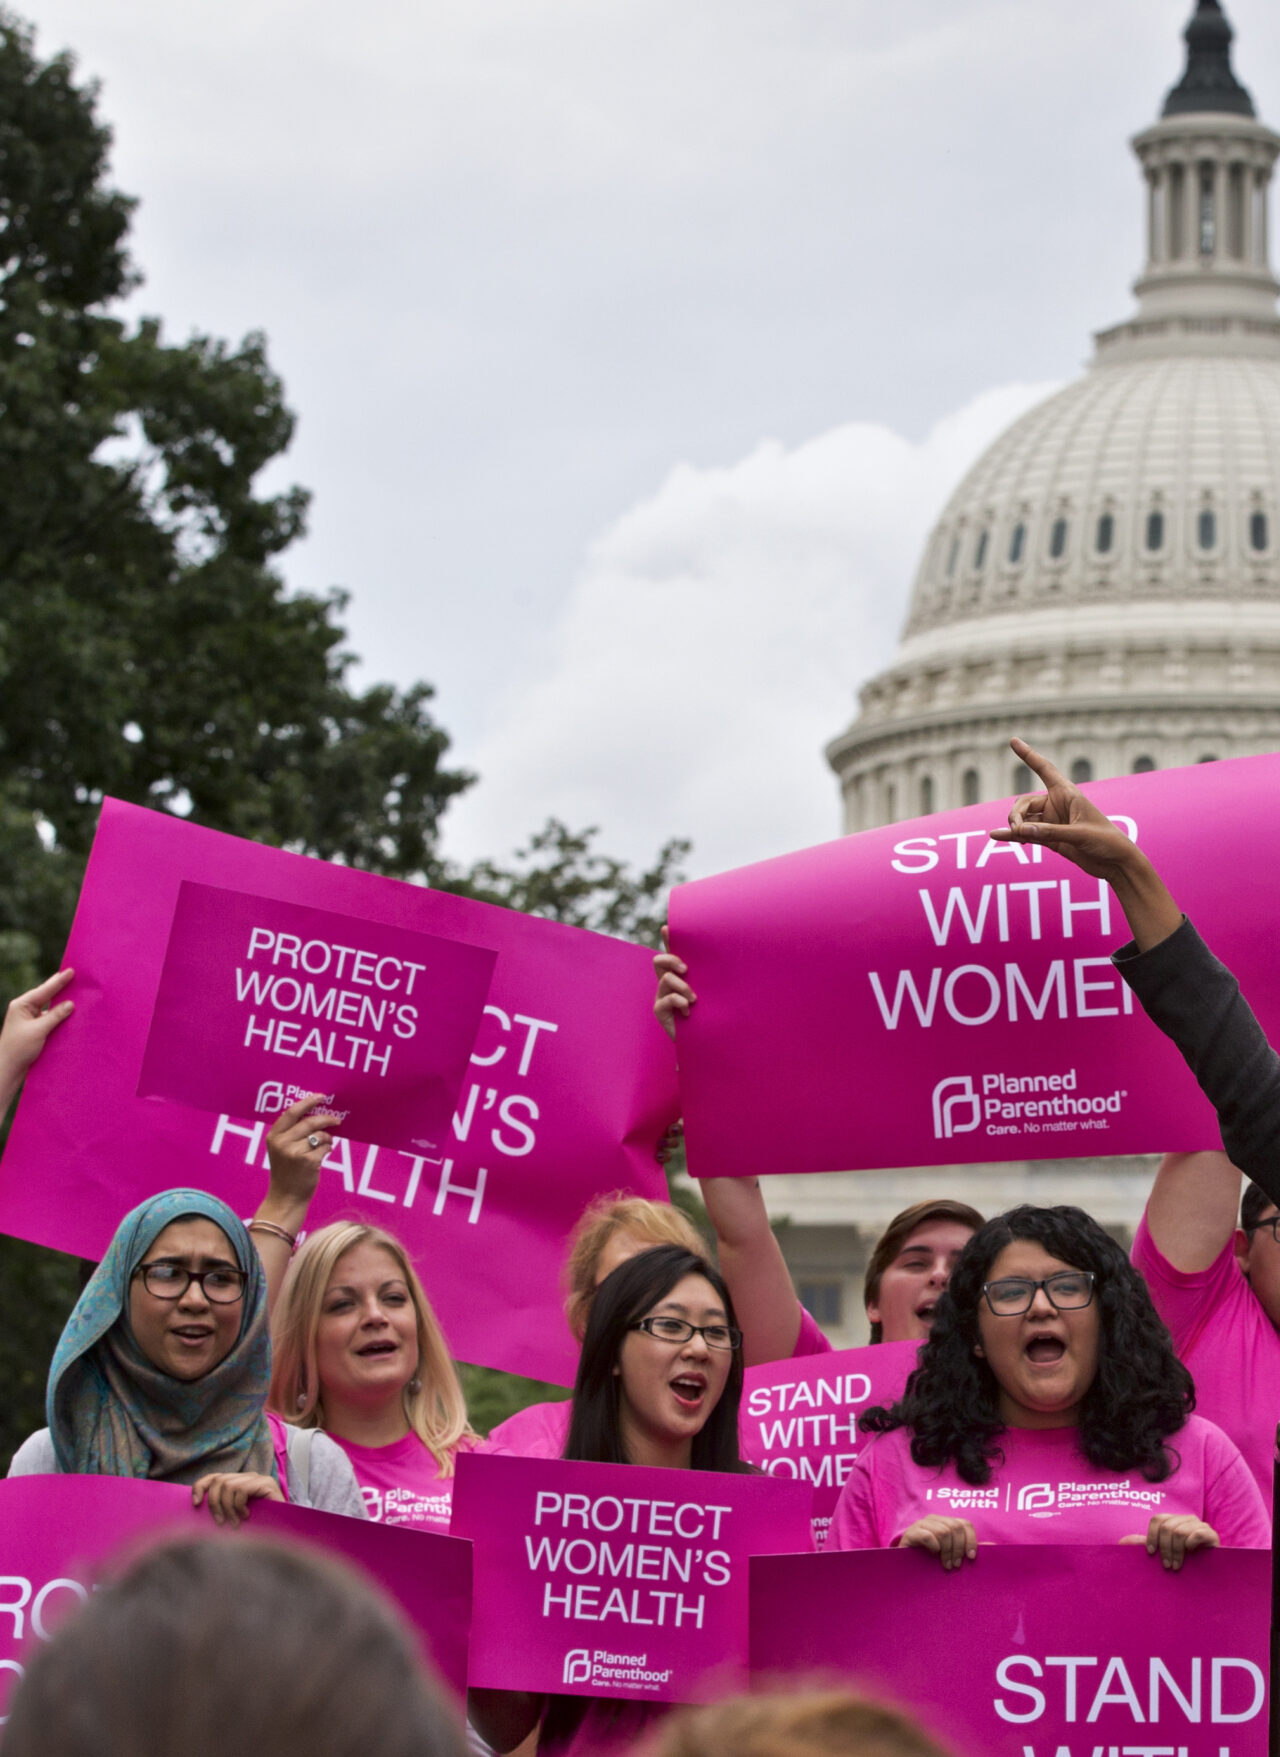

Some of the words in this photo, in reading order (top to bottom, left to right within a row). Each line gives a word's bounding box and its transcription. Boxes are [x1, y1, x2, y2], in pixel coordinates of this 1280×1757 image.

[891, 815, 1138, 874] STA
[918, 878, 1111, 947] WITH
[247, 927, 426, 995] PROTECT
[235, 967, 418, 1039] WOMEN'S
[244, 1014, 392, 1077] HEALTH
[982, 1068, 1077, 1095] Planned
[986, 1124, 1022, 1136] Care.
[1024, 1122, 1040, 1133] No
[1042, 1121, 1078, 1132] matter
[1080, 1118, 1110, 1130] what.
[210, 1113, 488, 1224] HALTH
[747, 1373, 872, 1416] STAND
[759, 1413, 856, 1450] WITH
[748, 1453, 858, 1488] OME
[1058, 1480, 1130, 1491] Planned
[385, 1501, 452, 1516] Parenth
[534, 1491, 732, 1540] PROTECT
[926, 1489, 933, 1500] I
[936, 1487, 999, 1498] Stand
[949, 1498, 998, 1509] With
[525, 1536, 731, 1586] WOMEN'S
[542, 1582, 705, 1629] HEALTH
[594, 1650, 646, 1667] Planned
[993, 1654, 1266, 1723] STAND
